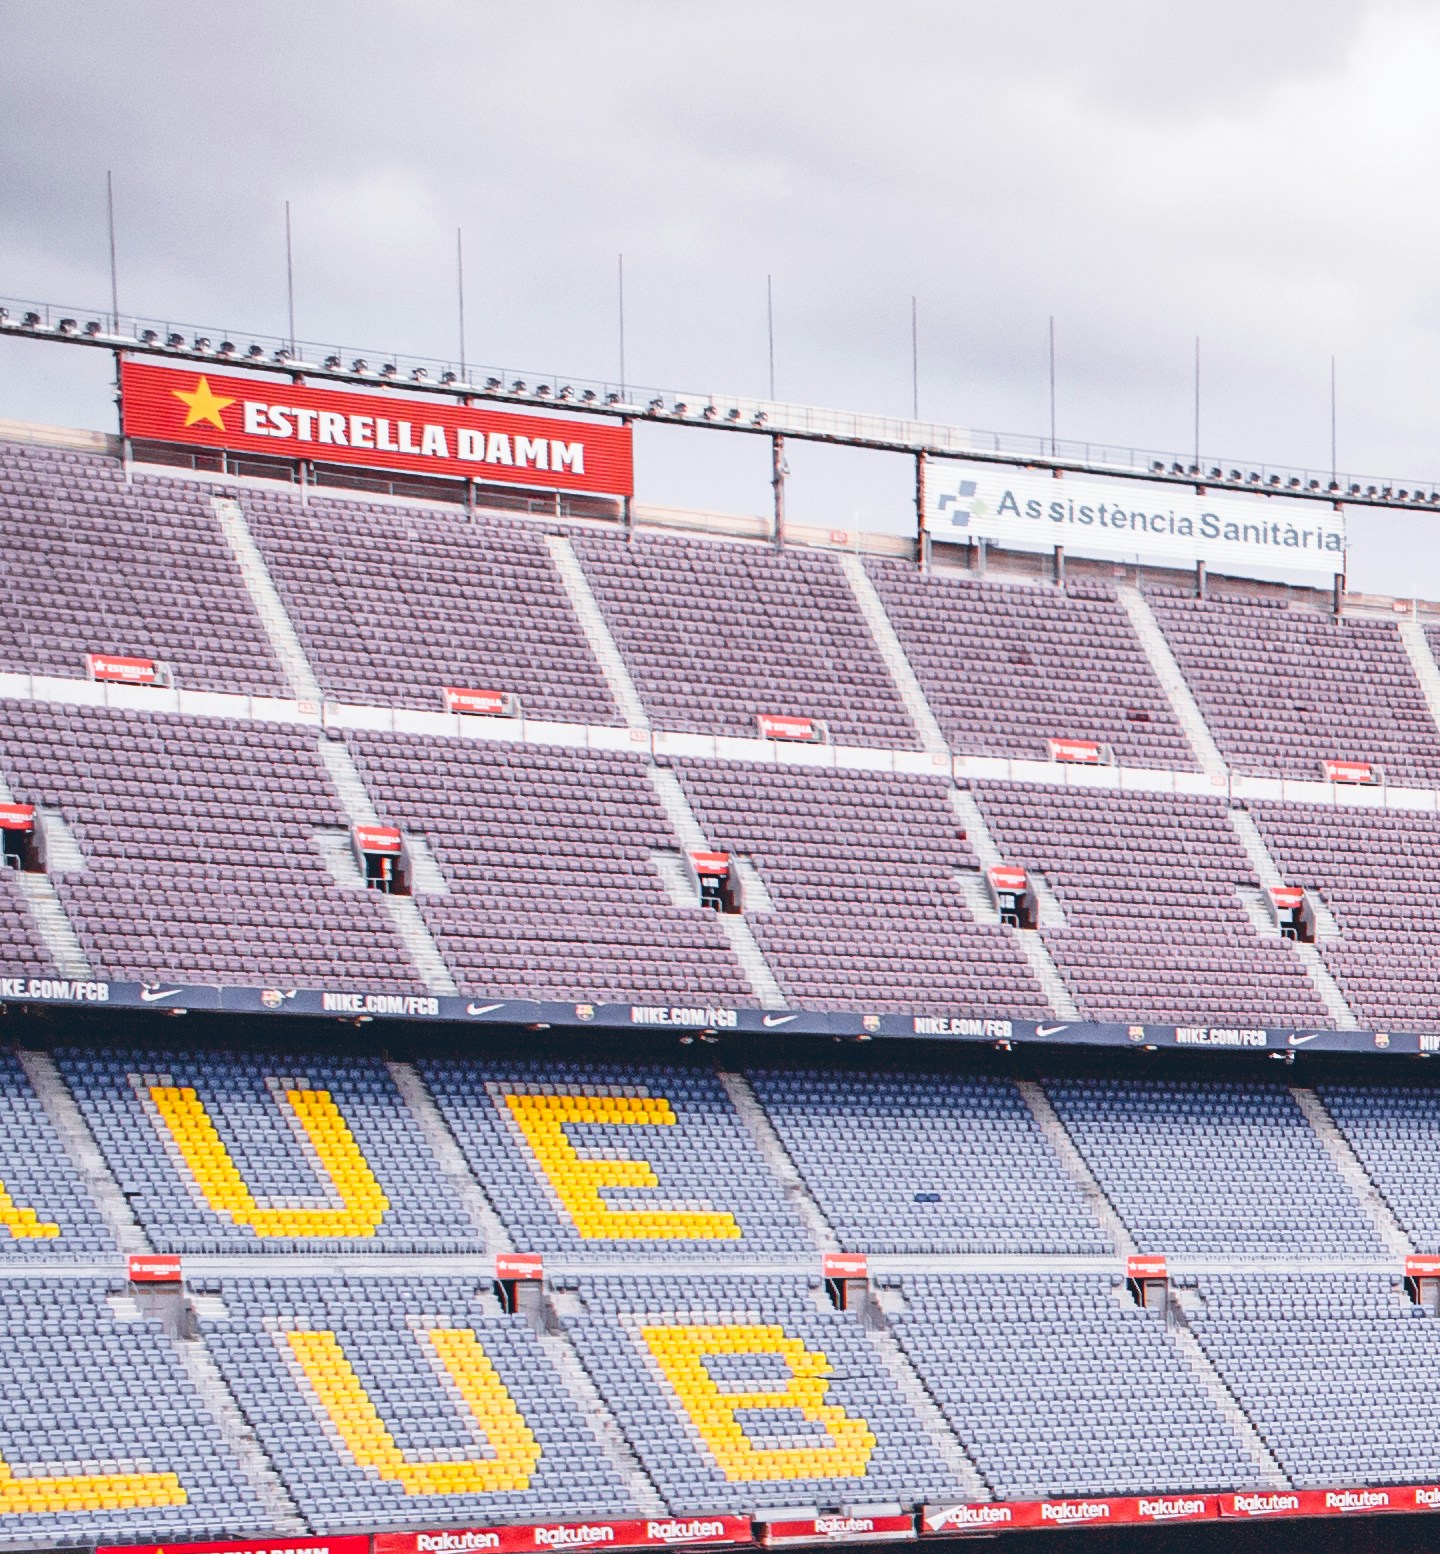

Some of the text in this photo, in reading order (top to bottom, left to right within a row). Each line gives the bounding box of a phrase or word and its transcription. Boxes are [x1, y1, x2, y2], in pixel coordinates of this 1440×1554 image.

[244, 401, 585, 474] ESTRELLA DAMM
[998, 489, 1343, 553] Assistència Sanitària
[0, 978, 109, 1001] KE.COM/FCB
[324, 994, 438, 1014] NIKE.COM/FCB
[633, 1005, 736, 1026] NIKE.COM/FCB
[915, 1017, 1011, 1036] NIKE.COM/FCB
[1177, 1028, 1266, 1045] NIKE.COM/FCB
[1139, 1499, 1204, 1519] Rakuten
[1235, 1495, 1298, 1515] Rakuten
[1326, 1491, 1388, 1510] Rakuten
[1042, 1502, 1109, 1523] Rakuten
[648, 1521, 723, 1542] Rakuten
[814, 1519, 873, 1533] Rakuten
[418, 1532, 498, 1554] Rakuten
[536, 1526, 613, 1548] Rakuten
